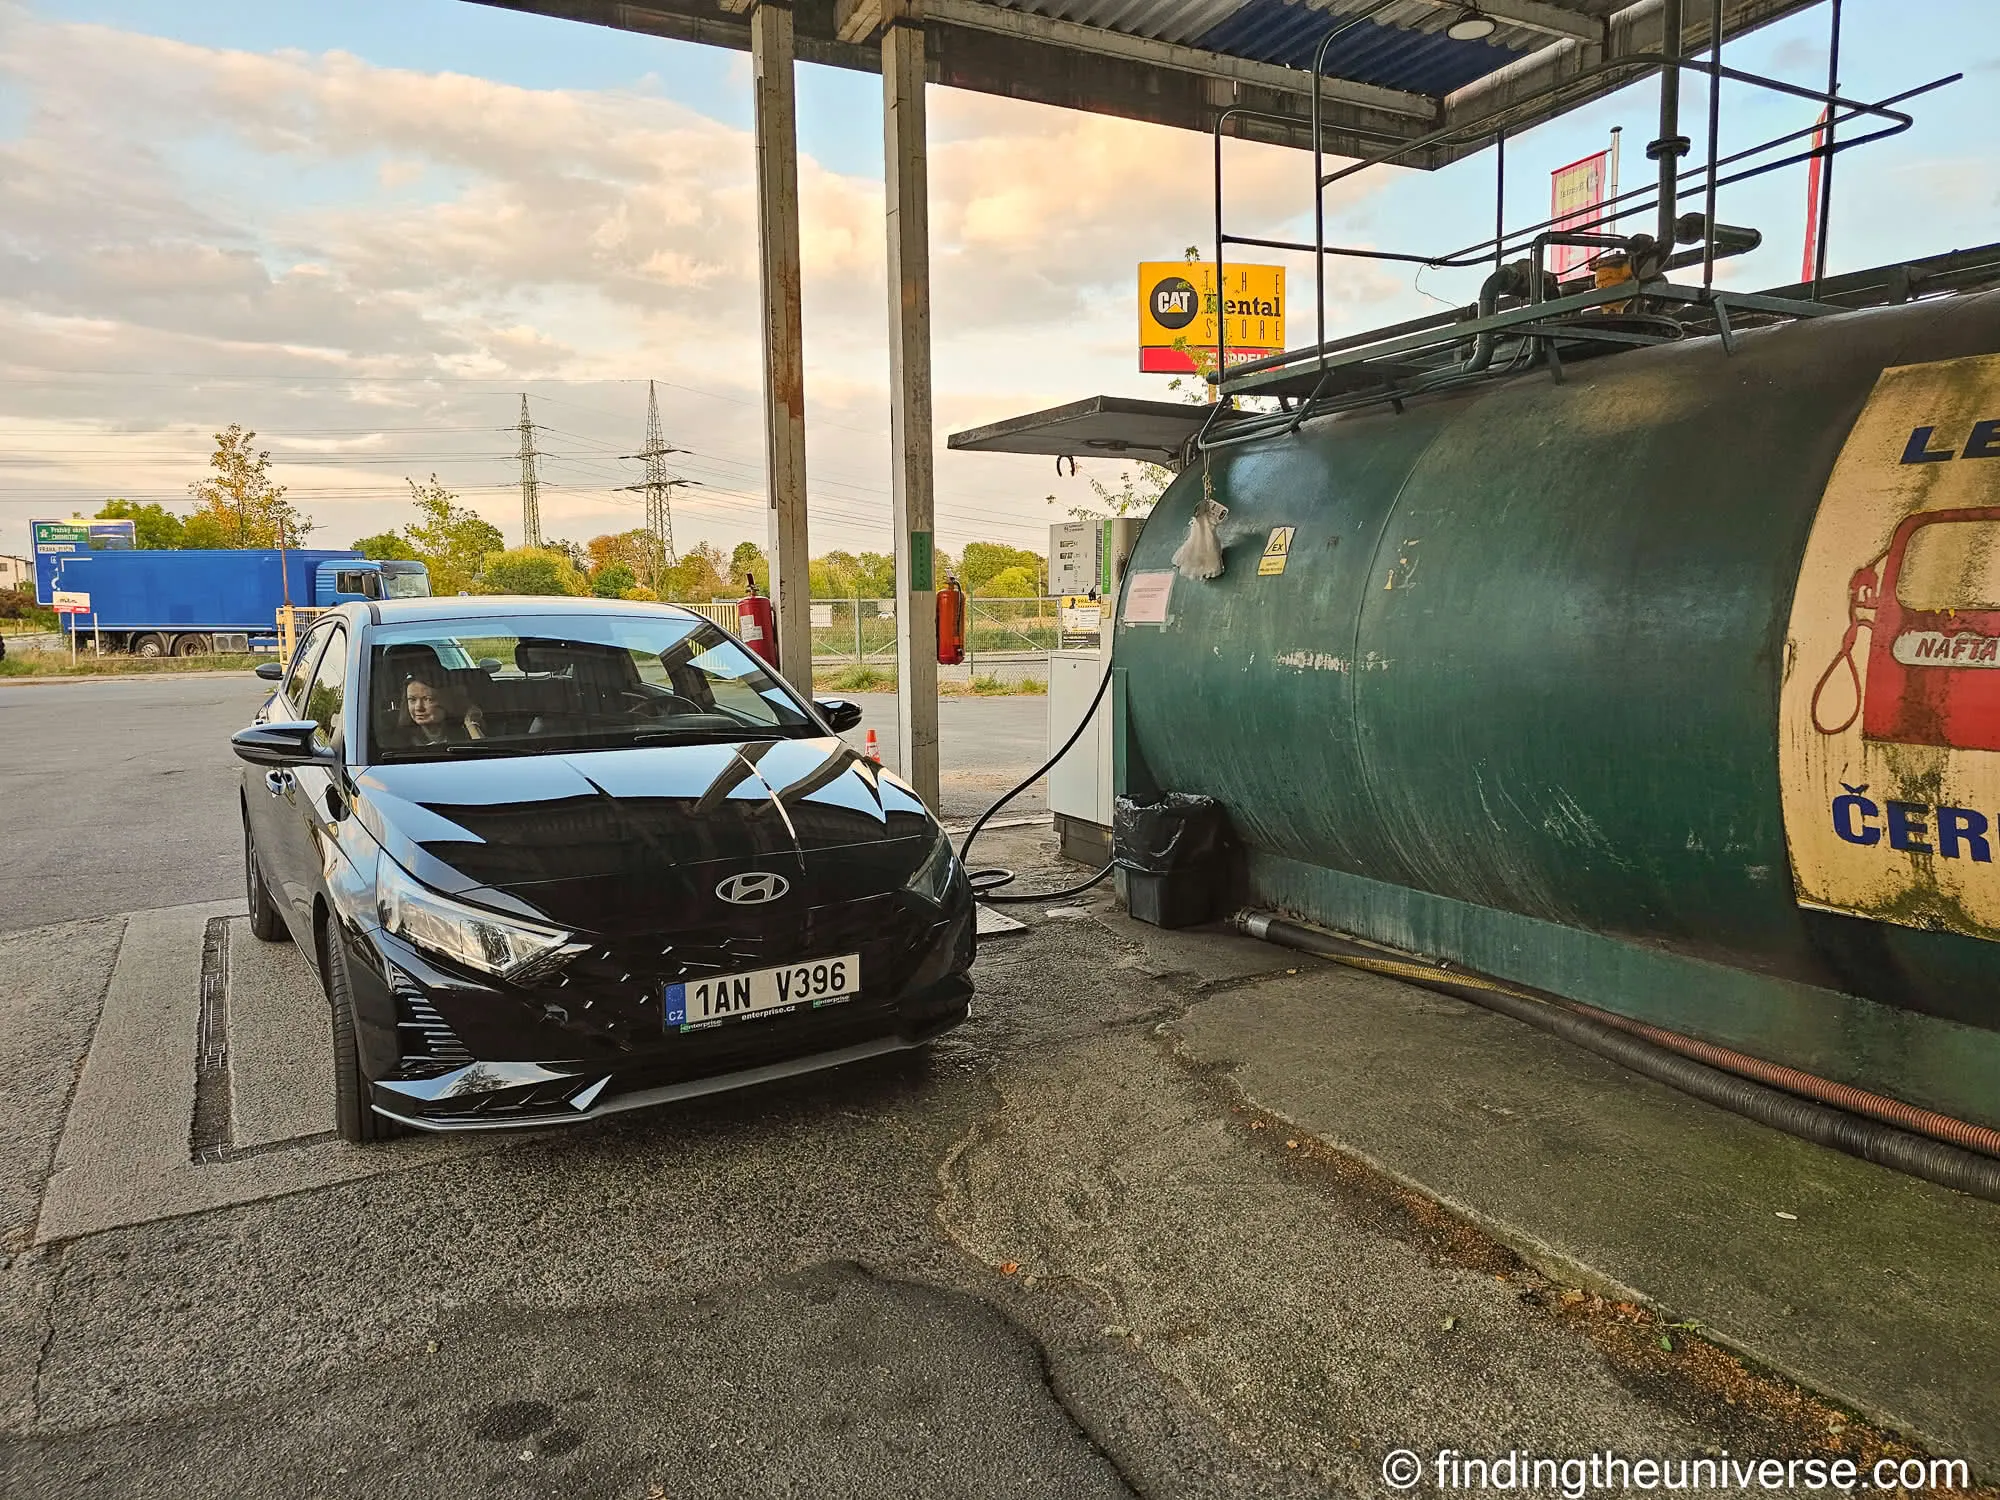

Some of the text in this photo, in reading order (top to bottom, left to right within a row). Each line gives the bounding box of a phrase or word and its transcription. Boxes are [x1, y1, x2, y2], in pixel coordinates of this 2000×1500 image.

[1204, 270, 1280, 295] THE
[1158, 291, 1190, 313] CAT
[1205, 318, 1281, 341] STORE
[1272, 543, 1284, 551] EX
[1915, 638, 1998, 661] NAFTA
[1832, 782, 2000, 863] ČER
[695, 962, 846, 1017] 1AN V396
[668, 1010, 684, 1022] CZ
[741, 1005, 796, 1021] enterprise.cz
